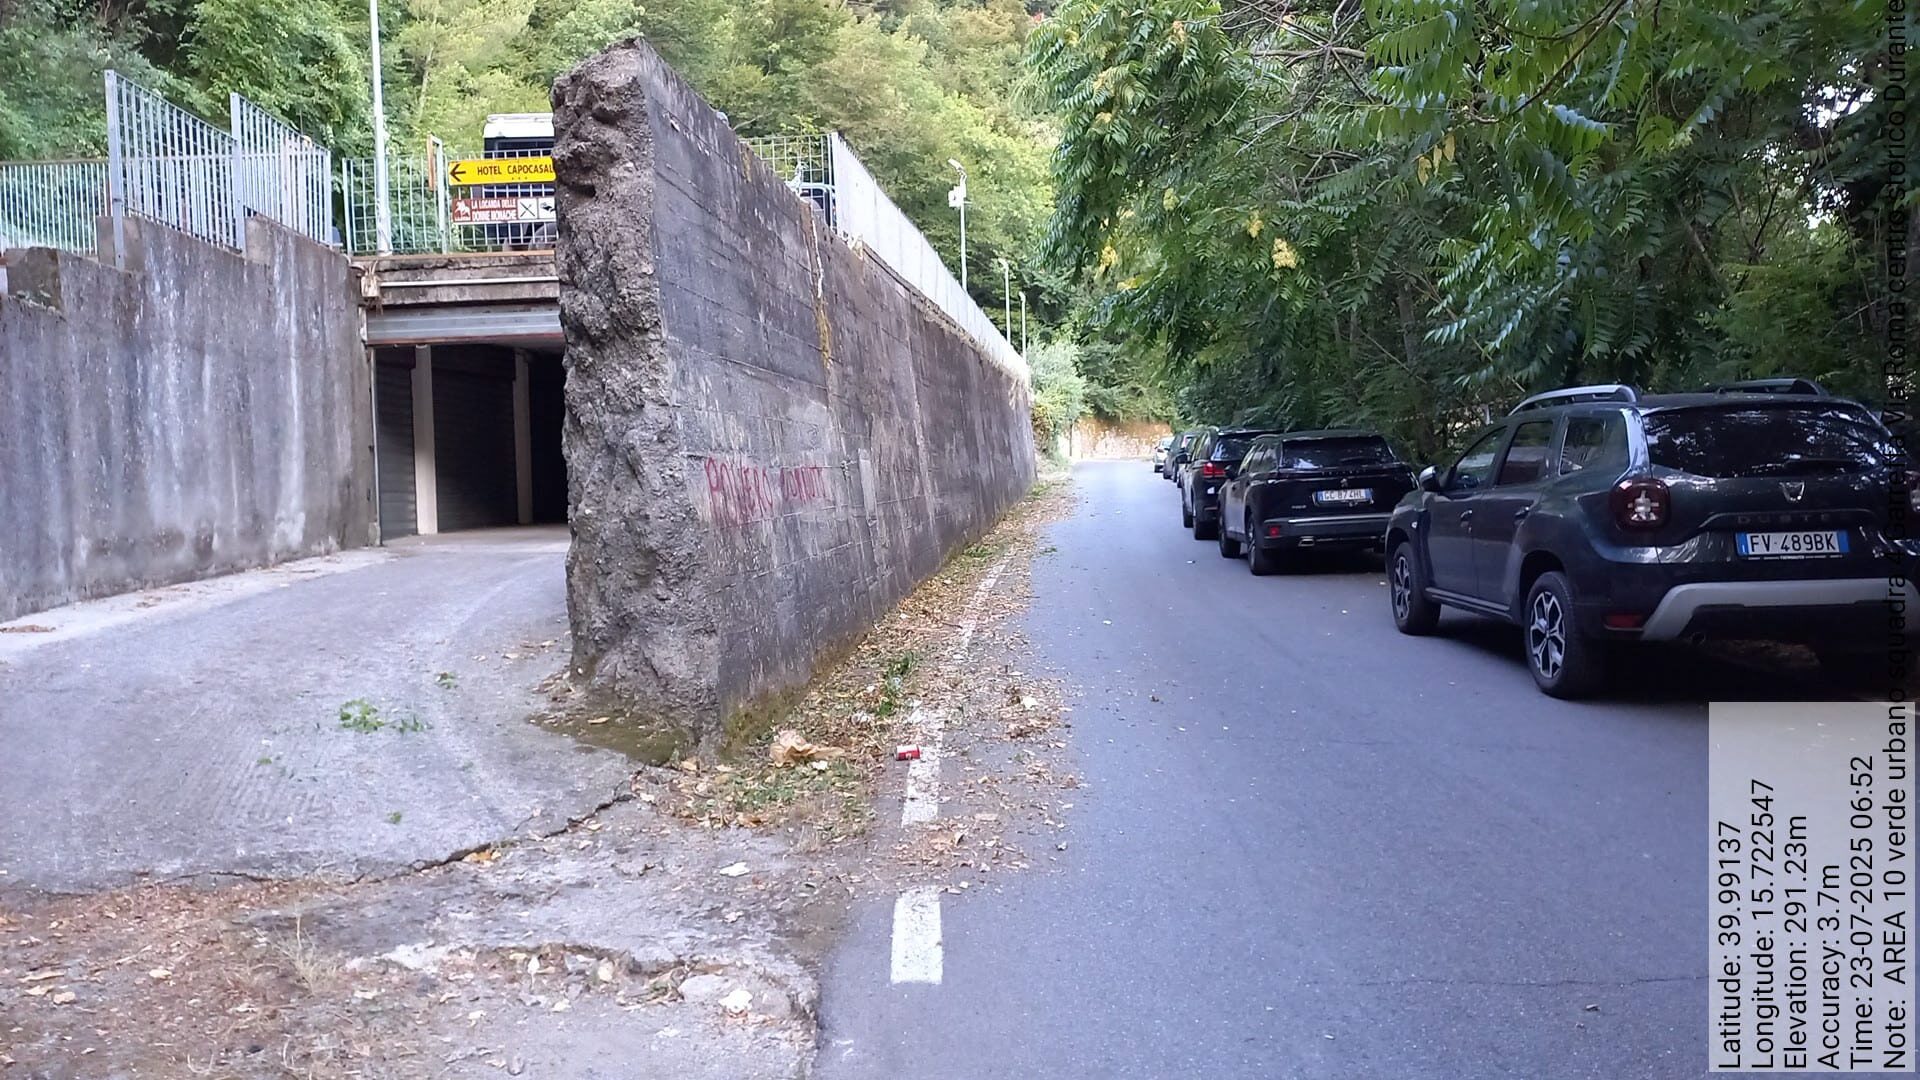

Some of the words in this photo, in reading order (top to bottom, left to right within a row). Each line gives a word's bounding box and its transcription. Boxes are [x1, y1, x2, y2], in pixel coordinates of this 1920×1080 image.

[477, 165, 502, 176] HOTEL
[1750, 534, 1770, 553] FV
[1781, 533, 1836, 552] 489BK
